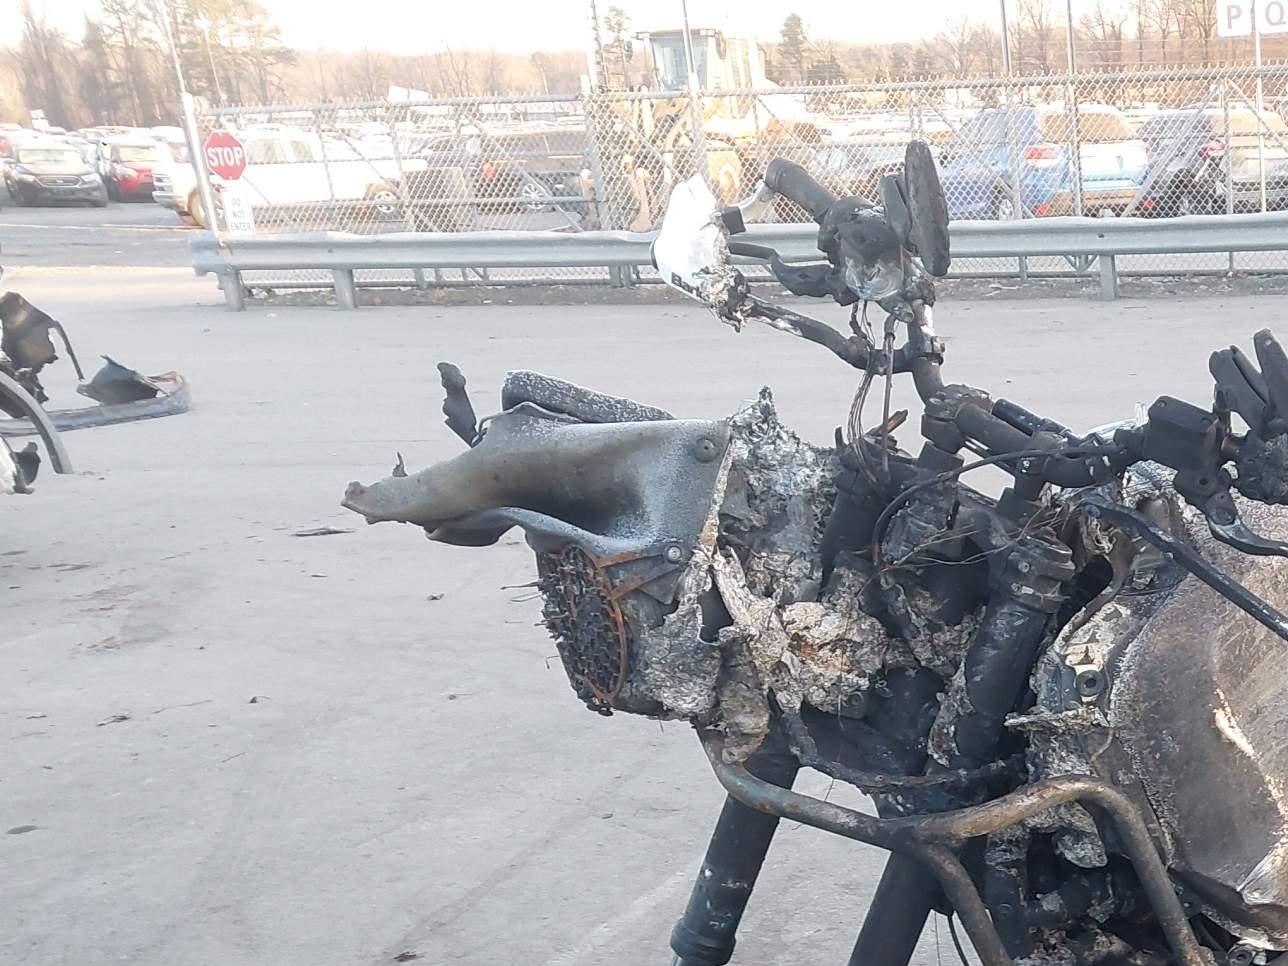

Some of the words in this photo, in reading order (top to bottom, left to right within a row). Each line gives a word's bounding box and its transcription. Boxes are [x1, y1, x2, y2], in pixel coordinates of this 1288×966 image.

[1226, 5, 1242, 29] P
[1265, 1, 1286, 26] Q
[207, 147, 242, 167] STOP
